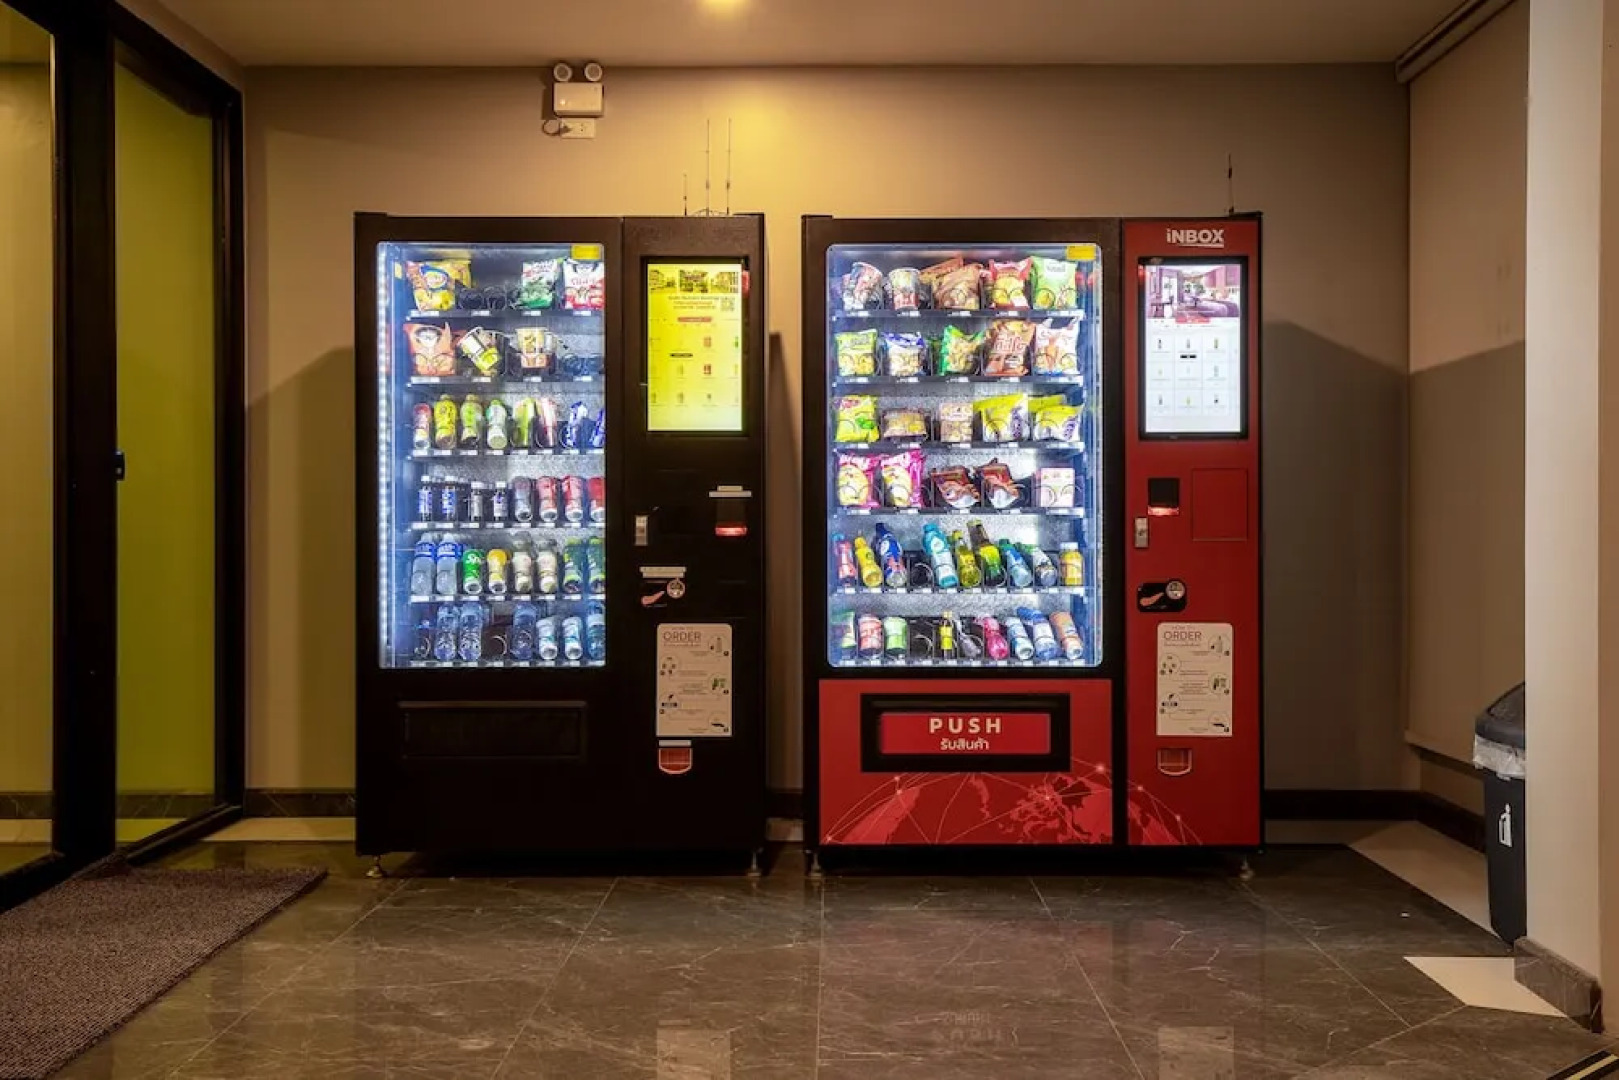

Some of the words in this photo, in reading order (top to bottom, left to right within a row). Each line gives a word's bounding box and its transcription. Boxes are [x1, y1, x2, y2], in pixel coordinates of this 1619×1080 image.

[663, 631, 701, 641] ORDER
[1164, 631, 1202, 641] ORDER
[929, 718, 1002, 734] PUSH
[940, 737, 990, 751] รับสินค้า
